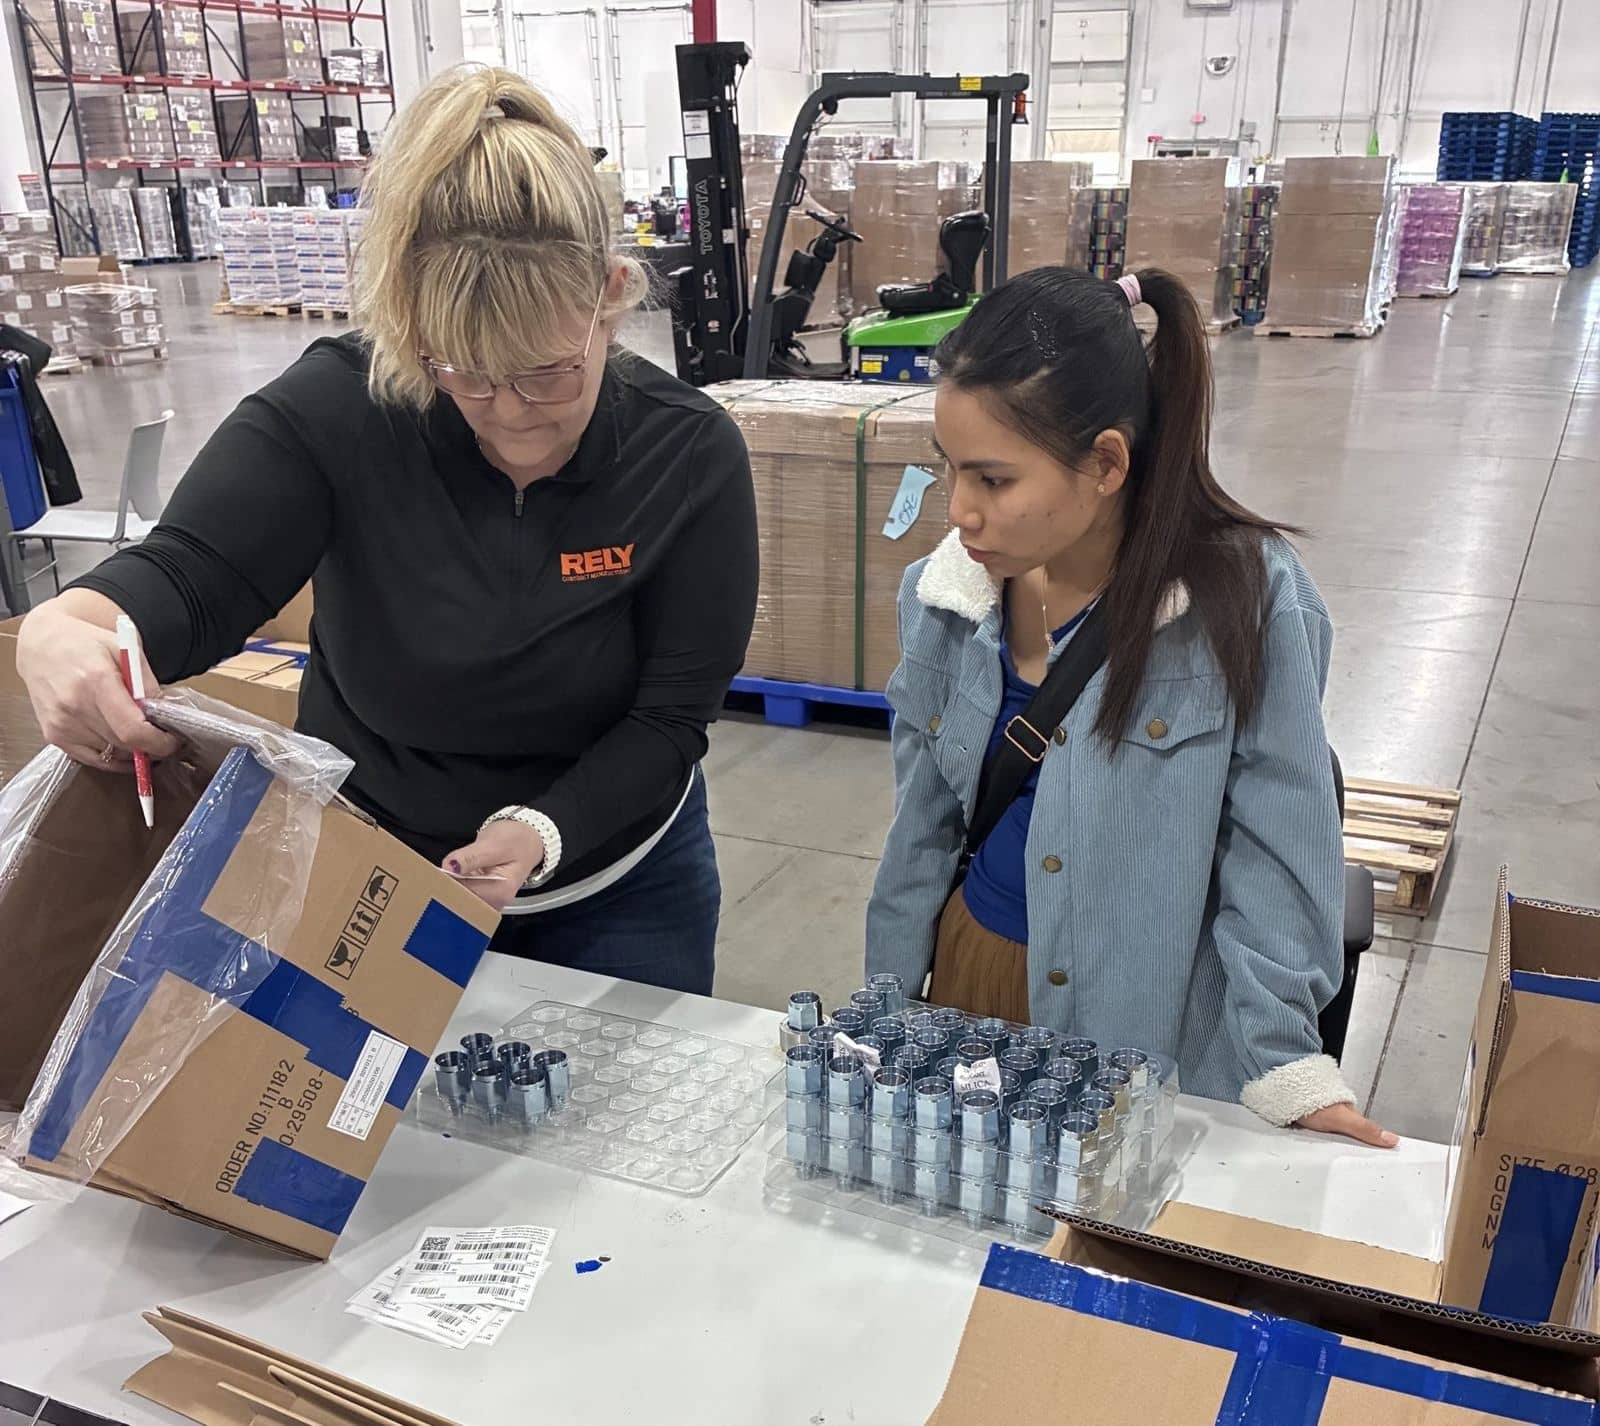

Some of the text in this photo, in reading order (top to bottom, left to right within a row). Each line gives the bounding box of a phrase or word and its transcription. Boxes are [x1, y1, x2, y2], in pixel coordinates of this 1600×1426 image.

[695, 179, 713, 256] TOYOTA
[560, 543, 635, 576] RELY
[245, 1059, 295, 1135] NO:111182
[278, 1096, 294, 1110] B
[215, 1140, 253, 1193] ORDER
